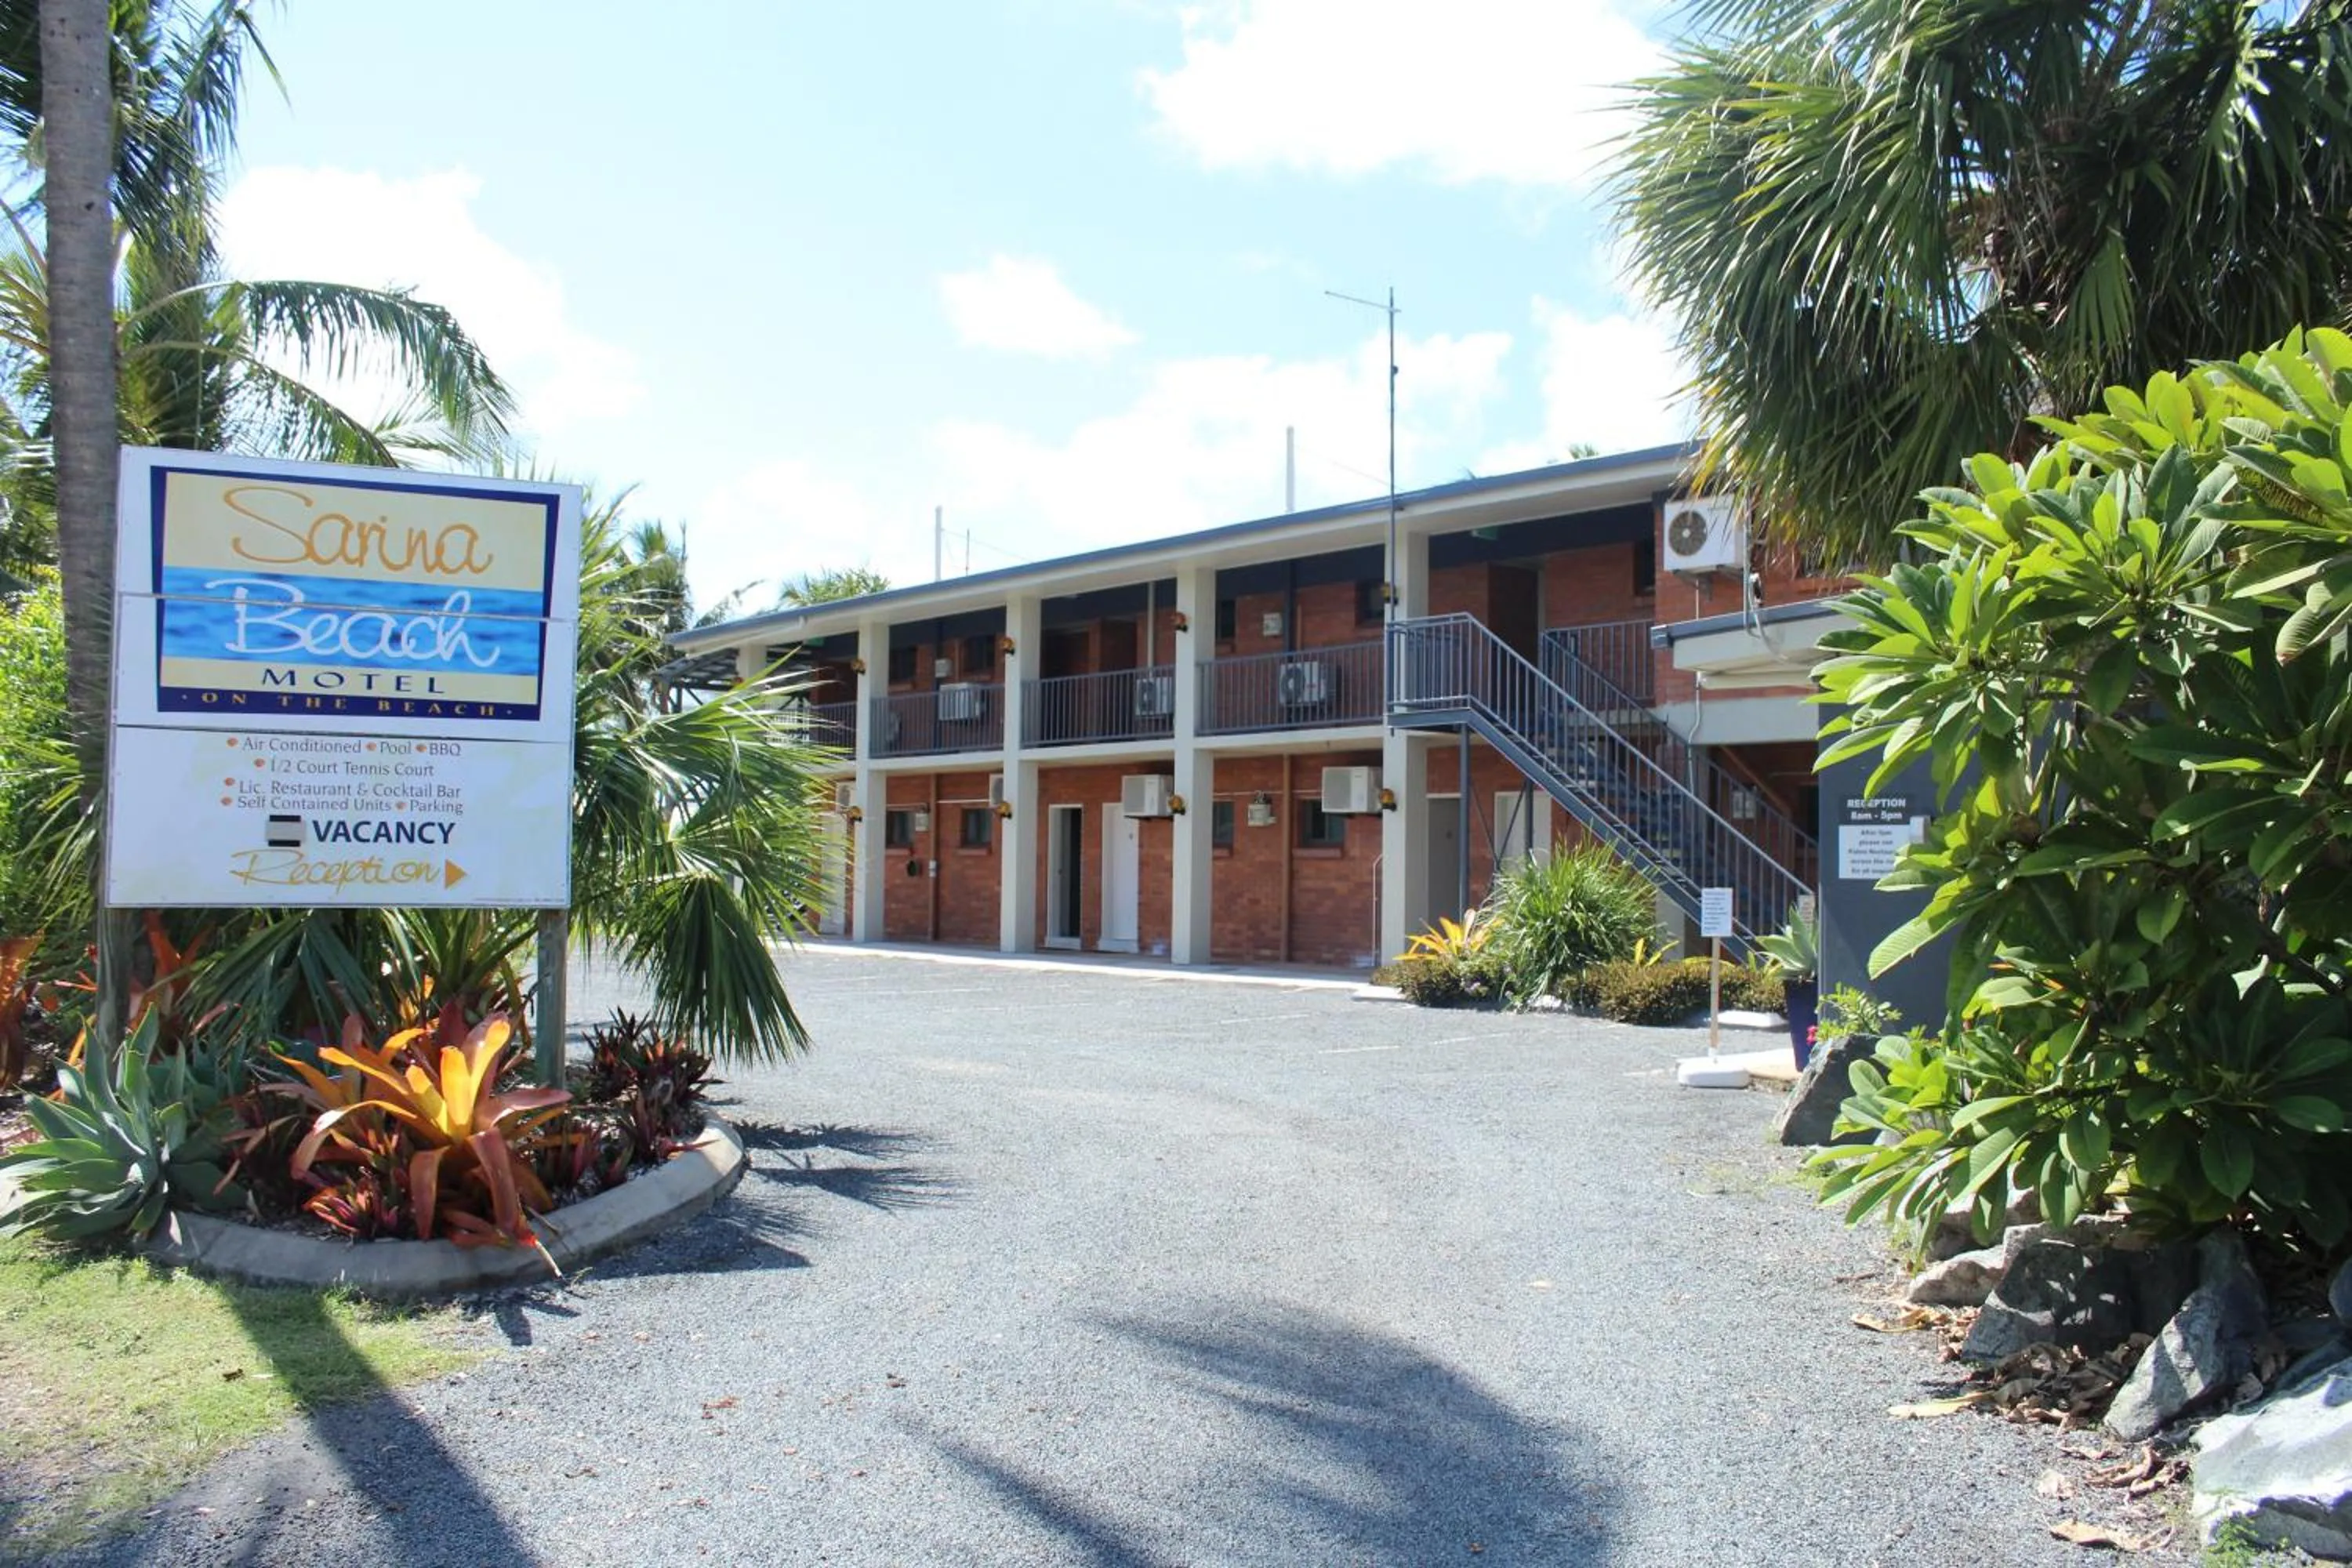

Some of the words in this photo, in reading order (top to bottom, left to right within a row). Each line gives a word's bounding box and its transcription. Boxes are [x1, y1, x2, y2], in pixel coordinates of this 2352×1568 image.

[223, 485, 493, 575] Sarina
[205, 578, 500, 667] Beach
[262, 668, 445, 694] MOTEL
[201, 692, 246, 704] ON
[278, 695, 347, 709] THE
[378, 700, 494, 716] BEACH
[242, 736, 265, 751] Air
[269, 738, 361, 753] Conditioned
[379, 740, 412, 755] Pool
[429, 742, 461, 757] BBQ
[296, 760, 338, 774] Court
[343, 761, 390, 775] Tennis
[394, 762, 434, 776] Court
[270, 780, 351, 796] Restaurant
[357, 782, 368, 795] &
[372, 782, 432, 797] Cocktail
[437, 785, 461, 798] Bar
[238, 796, 267, 808] Self
[270, 796, 348, 811] Contained
[354, 798, 391, 811] Units
[410, 799, 463, 815] Parking
[312, 819, 456, 844] VACANCY
[229, 848, 440, 895] Reception
